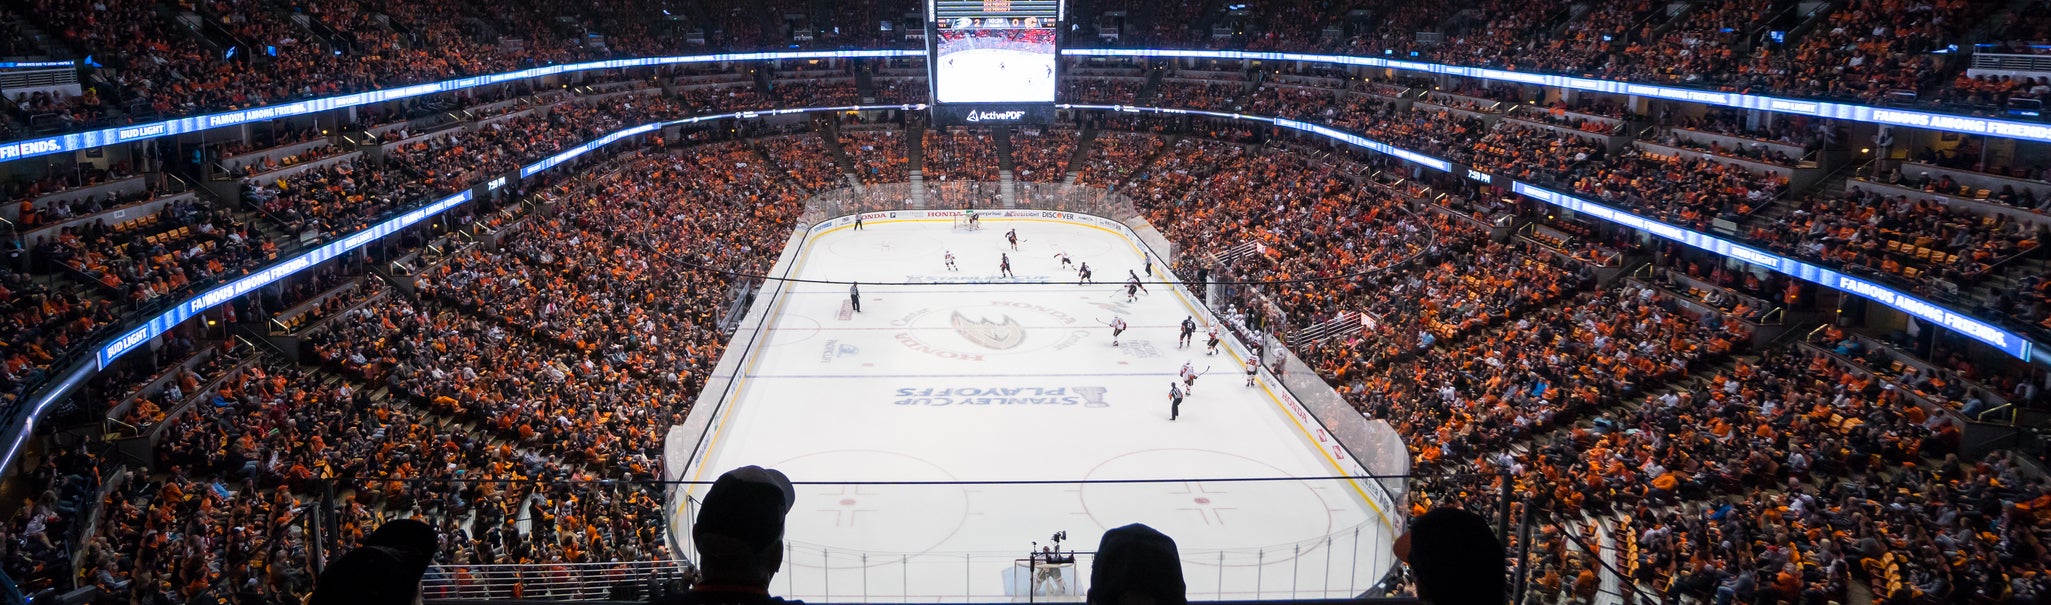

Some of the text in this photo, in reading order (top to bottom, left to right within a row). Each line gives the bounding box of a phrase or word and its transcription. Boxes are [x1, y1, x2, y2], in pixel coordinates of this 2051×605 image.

[975, 19, 980, 27] 2
[1012, 19, 1019, 27] 0
[211, 103, 307, 127] FAMOUS AMONG FRIENDS.
[980, 111, 1022, 120] ActivePDF
[1873, 110, 1929, 126] FAMOUS
[1929, 116, 1986, 132] AMONG
[120, 124, 165, 139] BUD LIGHT
[1042, 211, 1075, 220] DISCOVER
[191, 256, 309, 312] FAMOUS AMONG FRIENDS.
[1839, 276, 2007, 348] FAMOUS AMONG FRIENDS.
[107, 327, 147, 359] BUD LIGHT
[894, 331, 986, 362] HONDA
[895, 386, 1066, 397] PLAYOFFS
[893, 396, 1080, 407] STANLEY CUP
[1282, 391, 1308, 424] HONDA
